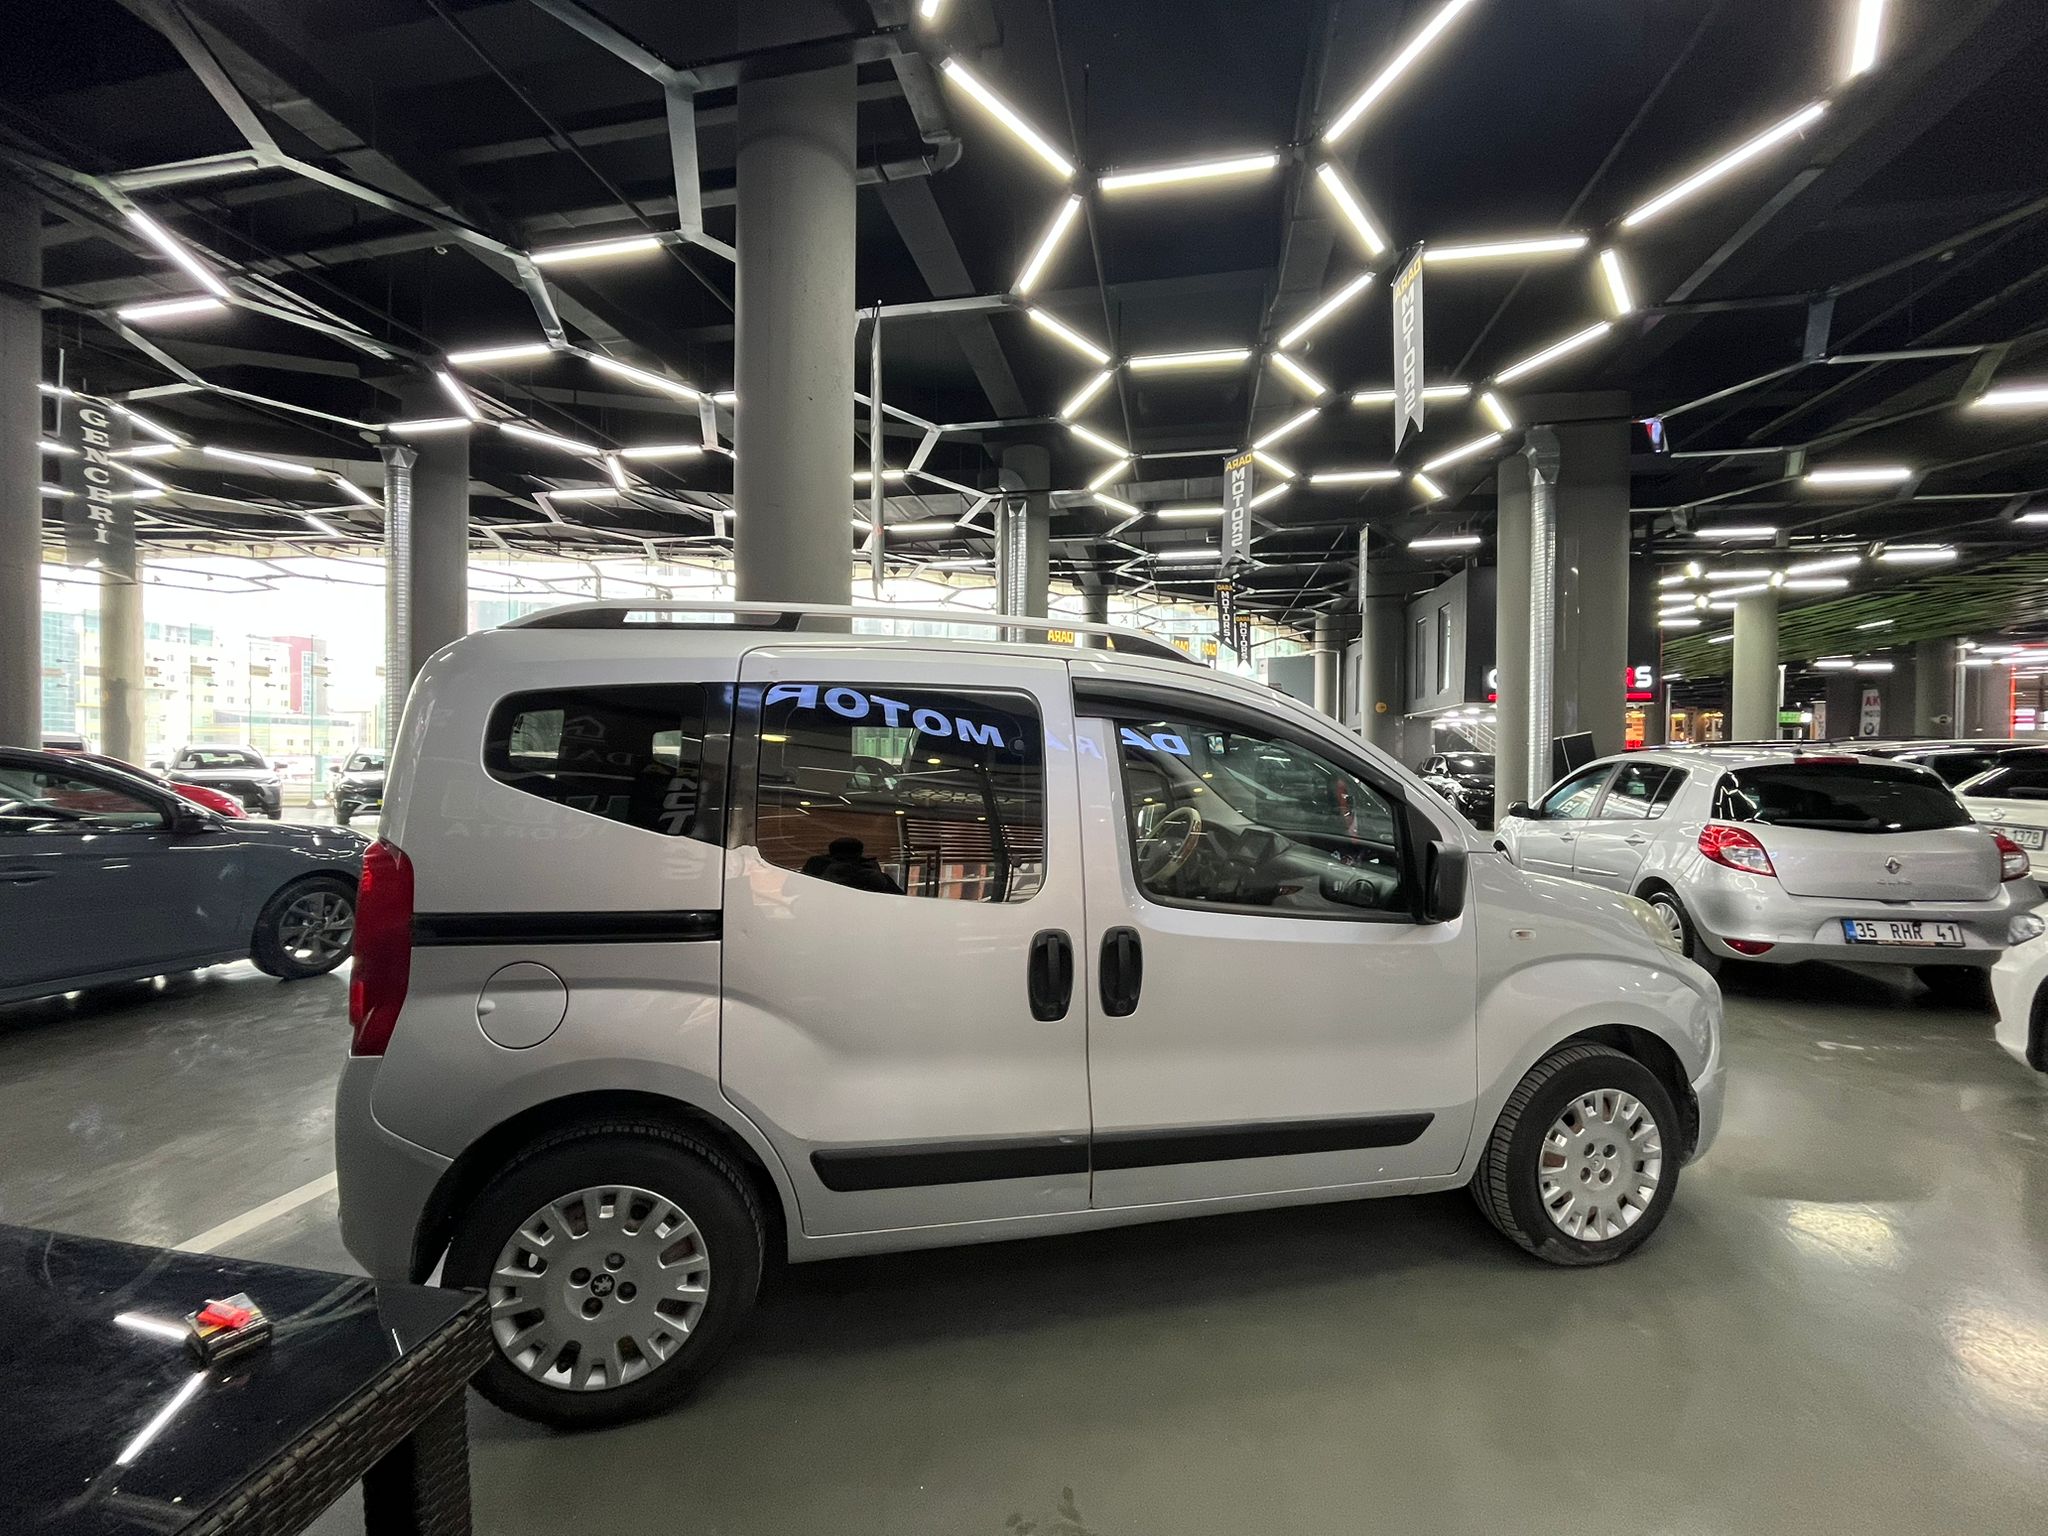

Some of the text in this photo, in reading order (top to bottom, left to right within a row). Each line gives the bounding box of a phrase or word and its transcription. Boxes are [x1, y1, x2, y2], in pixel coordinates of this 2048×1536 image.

[1221, 591, 1231, 636] MOTORS
[1240, 622, 1248, 660] MOTORS
[1855, 923, 1957, 941] 35 RHR 41
